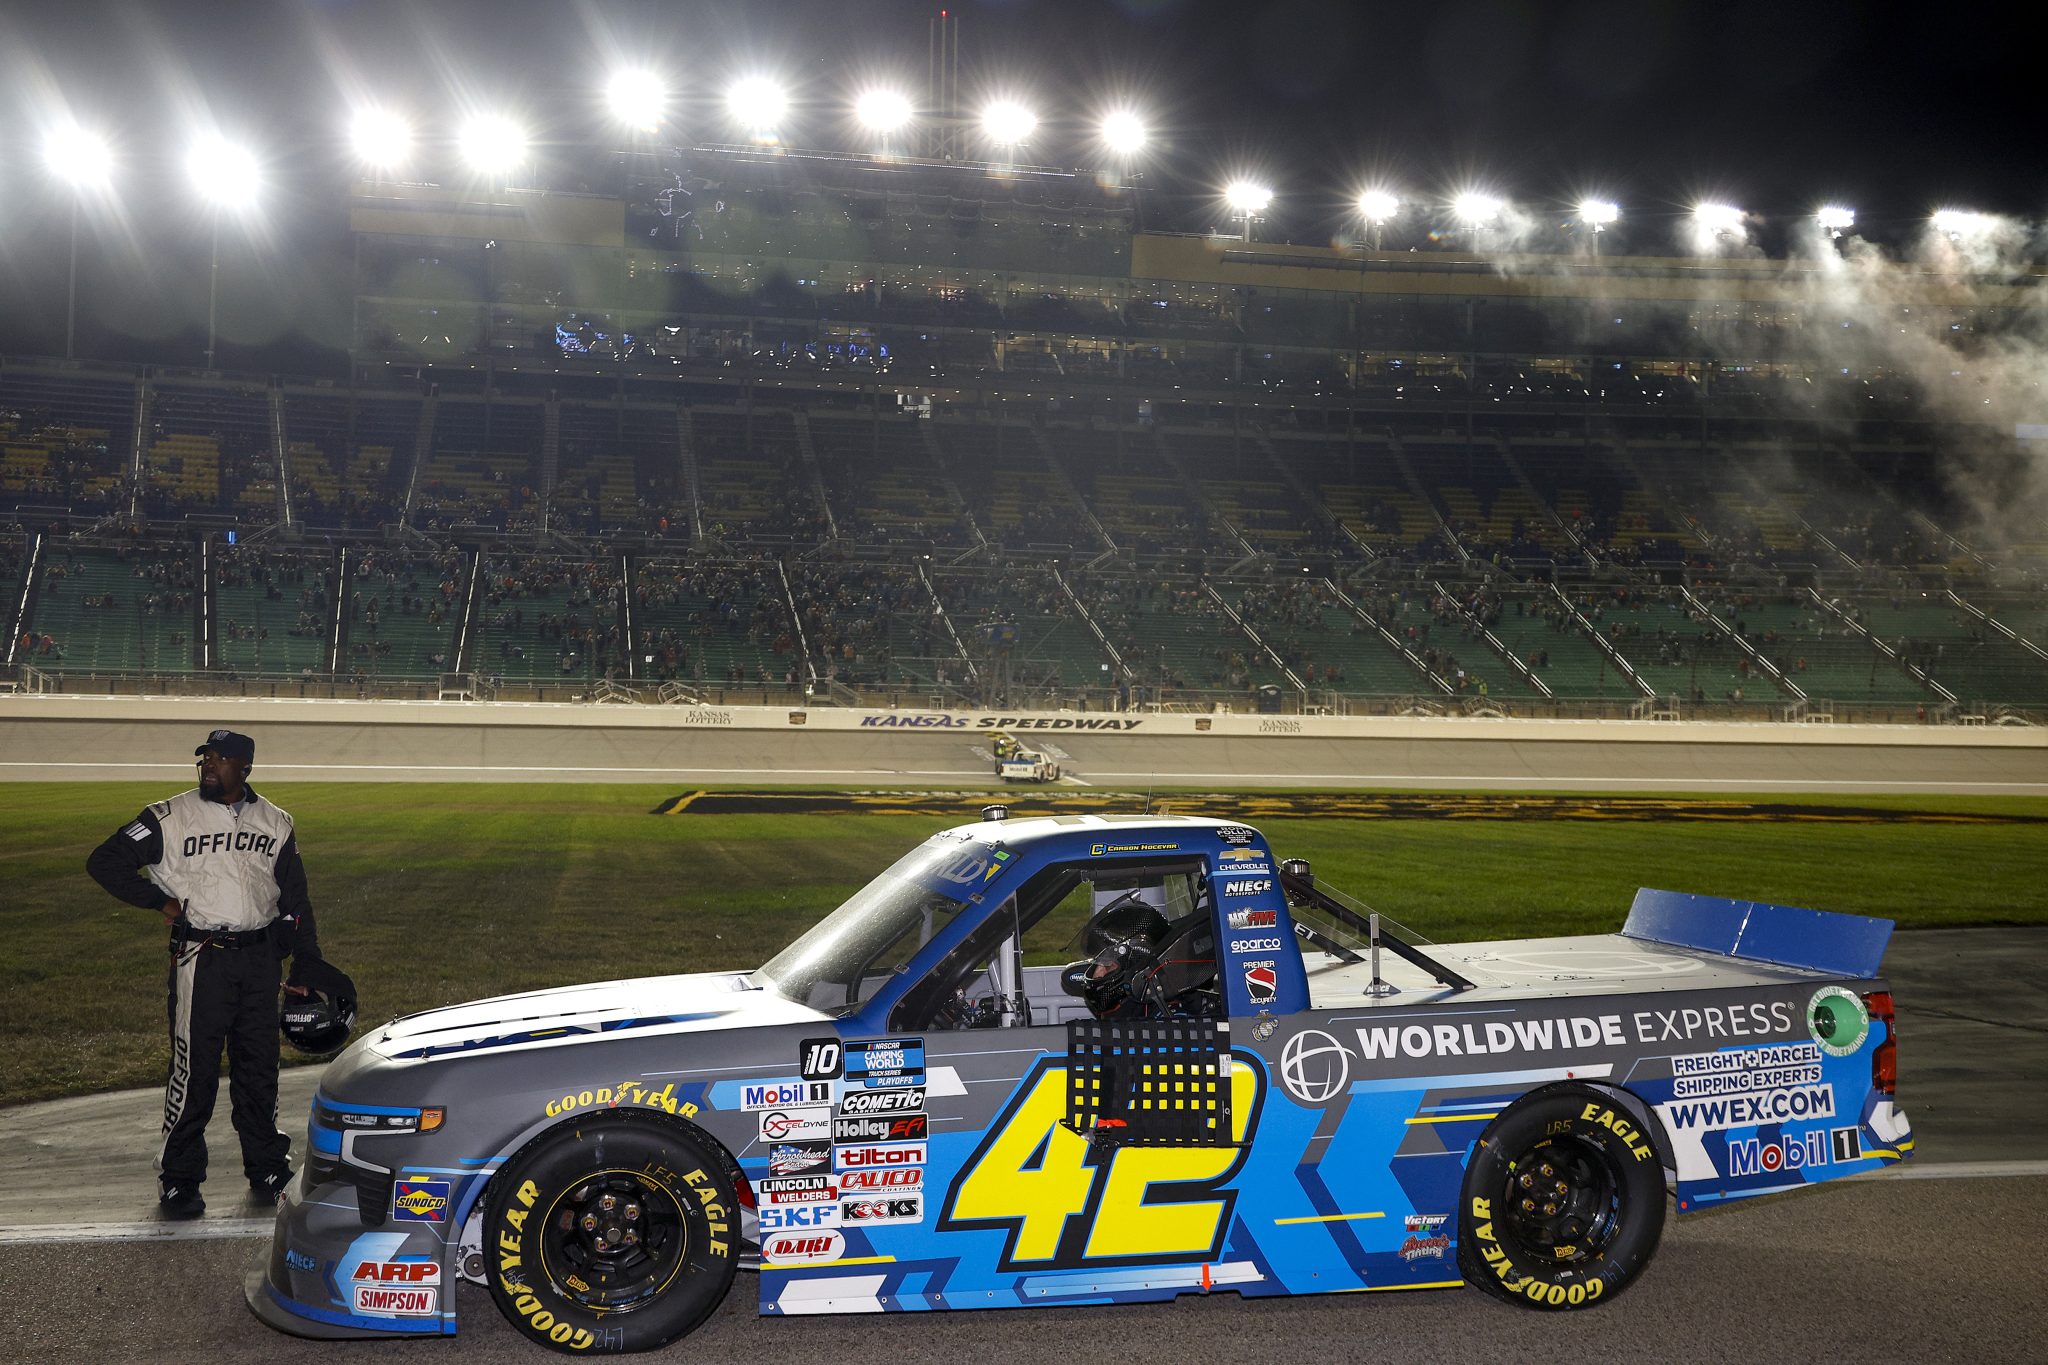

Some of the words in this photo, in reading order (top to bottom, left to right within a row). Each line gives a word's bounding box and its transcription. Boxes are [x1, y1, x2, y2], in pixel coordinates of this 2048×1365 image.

[685, 717, 733, 725] LOTTERY
[861, 714, 970, 728] KANSAS
[976, 718, 1144, 731] SPEEDWAY
[1262, 719, 1300, 727] KANSAS
[184, 831, 277, 858] OFFICIAL
[1219, 863, 1269, 871] CHEVROLET
[1226, 880, 1272, 893] NIECE
[1231, 938, 1281, 953] sparco
[1243, 960, 1275, 969] PREMIER
[875, 1042, 900, 1050] NASCAR
[1356, 1015, 1626, 1060] WORLDWIDE
[808, 1044, 840, 1074] 10
[864, 1051, 904, 1060] CAMPING
[865, 1058, 904, 1069] WORLD
[1674, 1053, 1743, 1074] FREIGHT
[1762, 1048, 1820, 1066] PARCEL
[162, 1035, 188, 1134] OFFICIAL
[877, 1077, 913, 1086] PLAYOFFS
[1677, 1074, 1749, 1095] SHIPPING
[1754, 1068, 1820, 1086] EXPERTS
[746, 1085, 803, 1105] Mobil
[843, 1089, 923, 1110] COMETIC
[1670, 1089, 1832, 1129] WWEX.COM
[835, 1120, 890, 1139] Holley
[890, 1118, 925, 1137] EFI
[1580, 1102, 1652, 1162] EAGLE
[770, 1147, 830, 1162] Arrowhead
[841, 1149, 922, 1166] tilton
[944, 1058, 1260, 1264] 42
[1731, 1130, 1826, 1175] Mobil
[763, 1178, 824, 1192] LINCOLN
[841, 1169, 922, 1188] CALICO
[397, 1197, 445, 1208] SUNOCO
[777, 1191, 830, 1203] WELDERS
[682, 1168, 729, 1258] EAGLE
[760, 1206, 837, 1227] SKF
[843, 1199, 918, 1221] KOOKS
[775, 1236, 836, 1255] DART
[1472, 1196, 1603, 1305] GOODYEAR
[353, 1262, 439, 1281] ARP
[499, 1178, 594, 1350] GOODYEAR
[361, 1290, 428, 1310] SIMPSON
